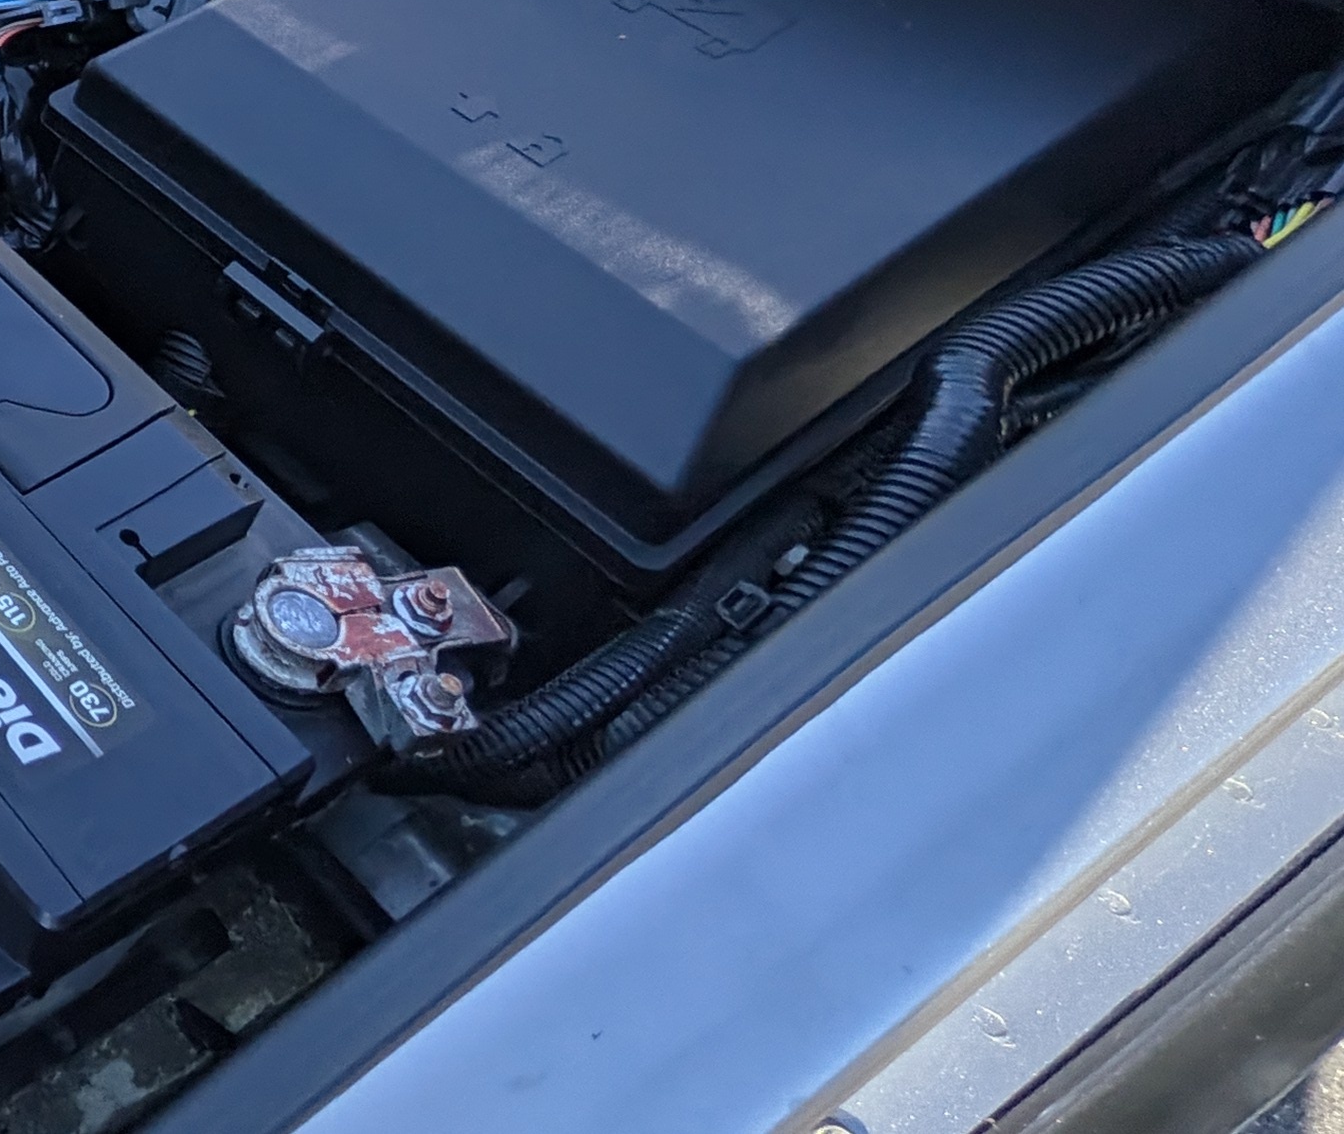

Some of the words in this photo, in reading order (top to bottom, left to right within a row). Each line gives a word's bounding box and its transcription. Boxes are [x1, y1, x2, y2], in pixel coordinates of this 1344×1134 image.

[3, 563, 31, 591] Auto
[23, 587, 69, 634] Advance
[65, 677, 112, 722] 730
[76, 647, 137, 710] Distributed
